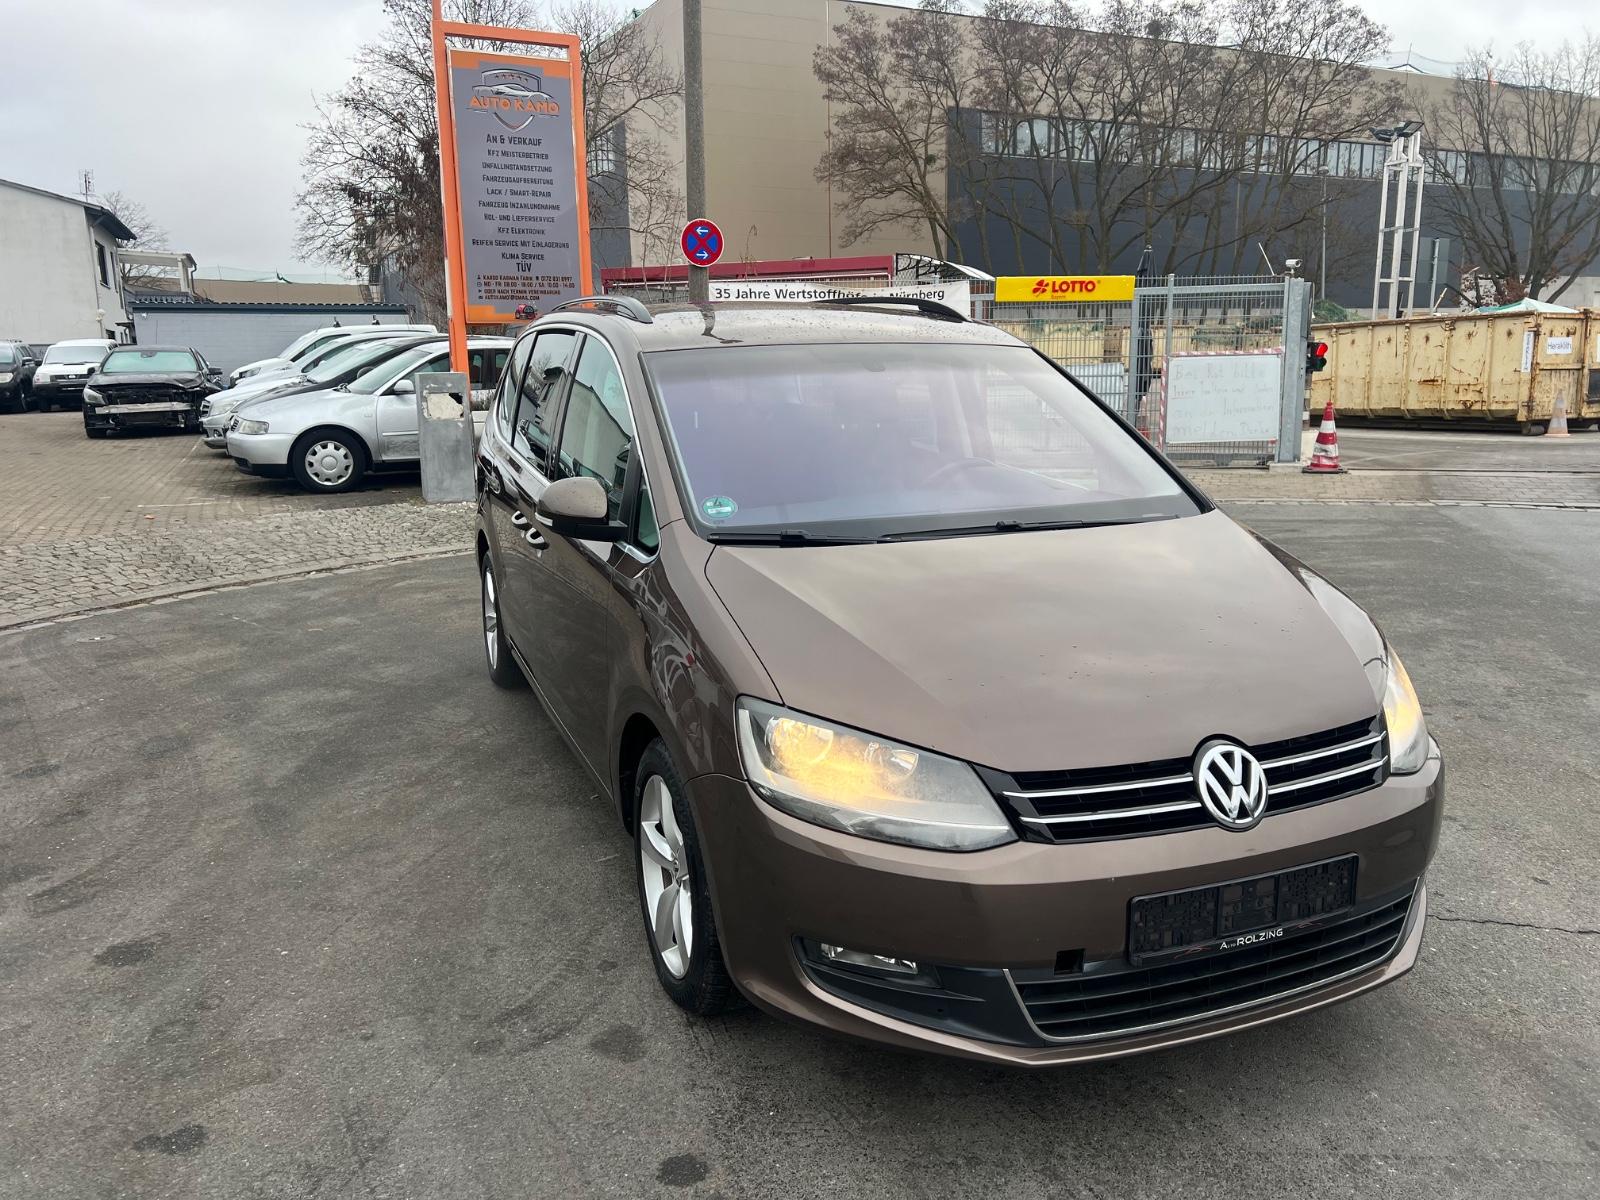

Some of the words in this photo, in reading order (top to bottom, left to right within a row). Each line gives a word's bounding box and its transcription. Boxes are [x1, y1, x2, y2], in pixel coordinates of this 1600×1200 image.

[470, 96, 511, 110] AUTO
[500, 134, 505, 144] &
[508, 136, 542, 146] VERKAUF
[500, 150, 548, 160] MEISTERBETRIEB
[486, 188, 502, 196] LACK
[478, 200, 508, 208] FAHRZEUG
[512, 214, 556, 223] LIEFERSERVICE
[502, 252, 520, 260] KLIMA
[516, 260, 532, 272] TÜV
[1052, 280, 1096, 293] LOTTO
[715, 288, 731, 298] 35
[736, 288, 770, 300] Jahre
